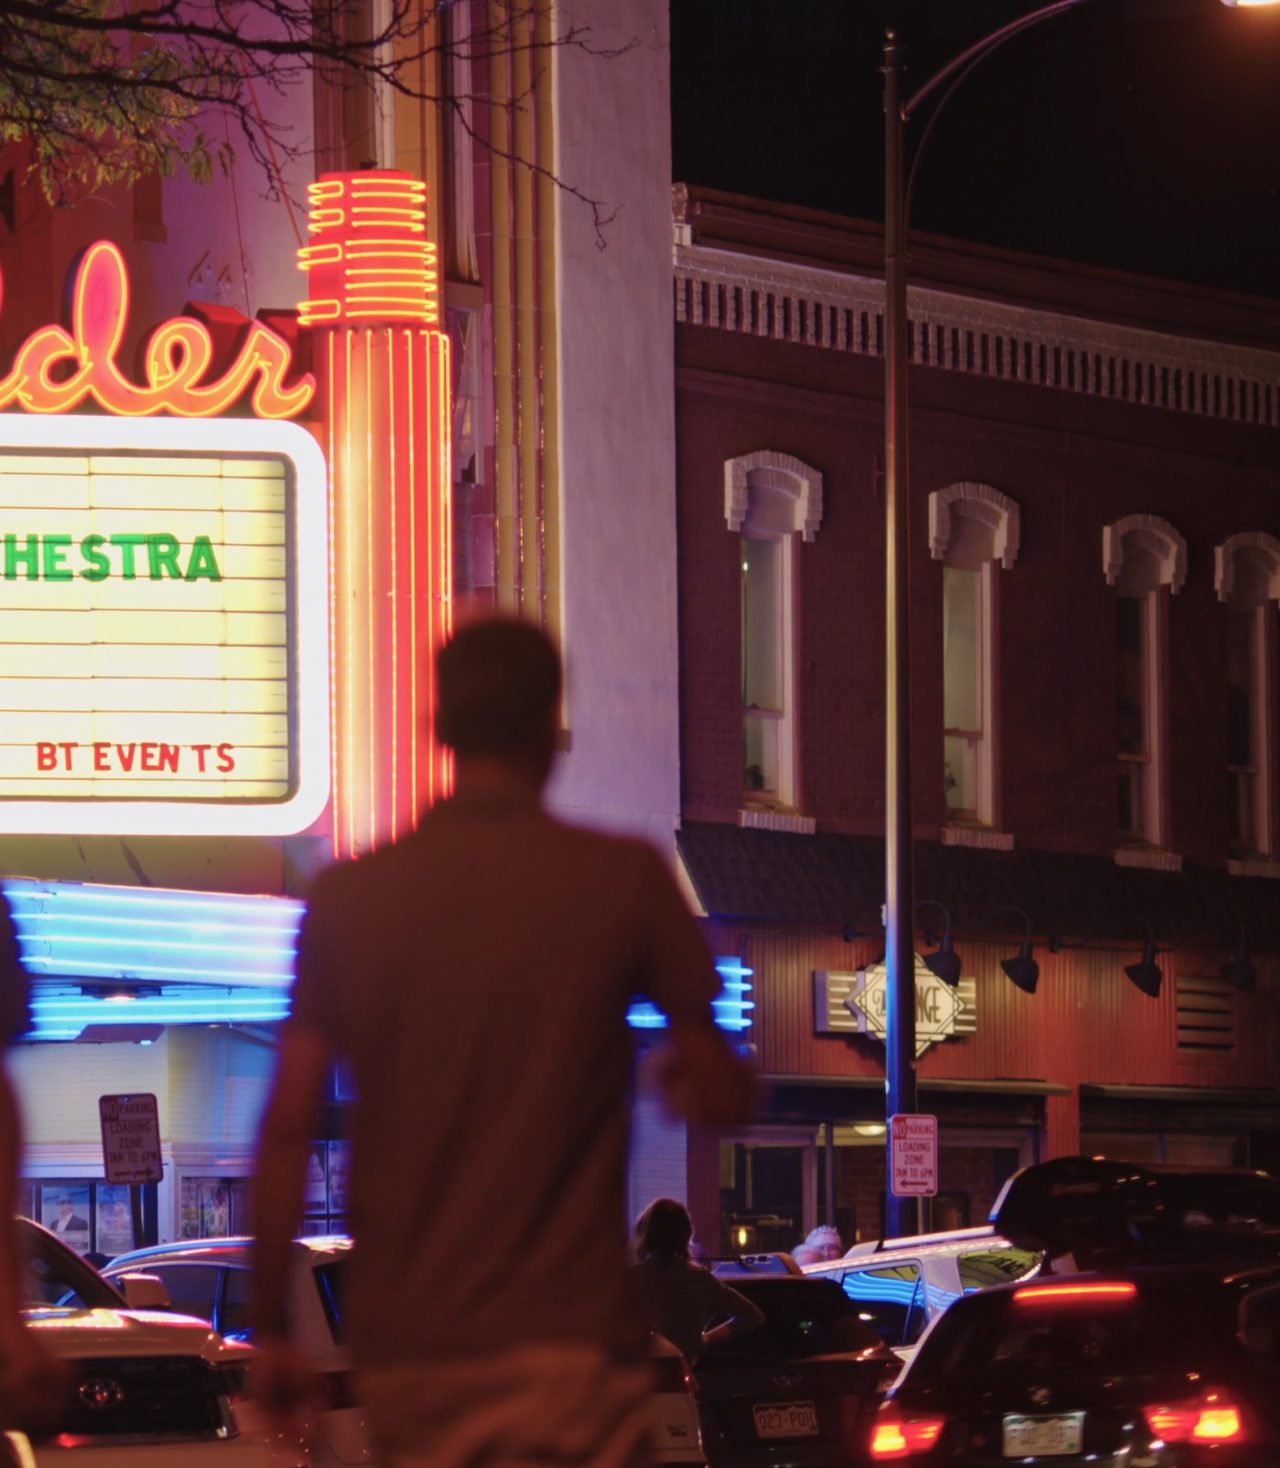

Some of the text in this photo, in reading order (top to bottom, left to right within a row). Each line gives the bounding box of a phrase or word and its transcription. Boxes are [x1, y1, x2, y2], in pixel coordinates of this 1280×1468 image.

[36, 741, 79, 772] BT
[93, 741, 236, 773] EVENTS
[103, 1100, 154, 1119] NO PARKING
[110, 1122, 152, 1135] LOADING
[894, 1121, 933, 1137] NO PARKING
[118, 1137, 145, 1149] ZONE
[898, 1141, 931, 1153] LOADING
[128, 1151, 138, 1163] TO
[904, 1154, 925, 1165] ZONE
[910, 1168, 918, 1178] TO
